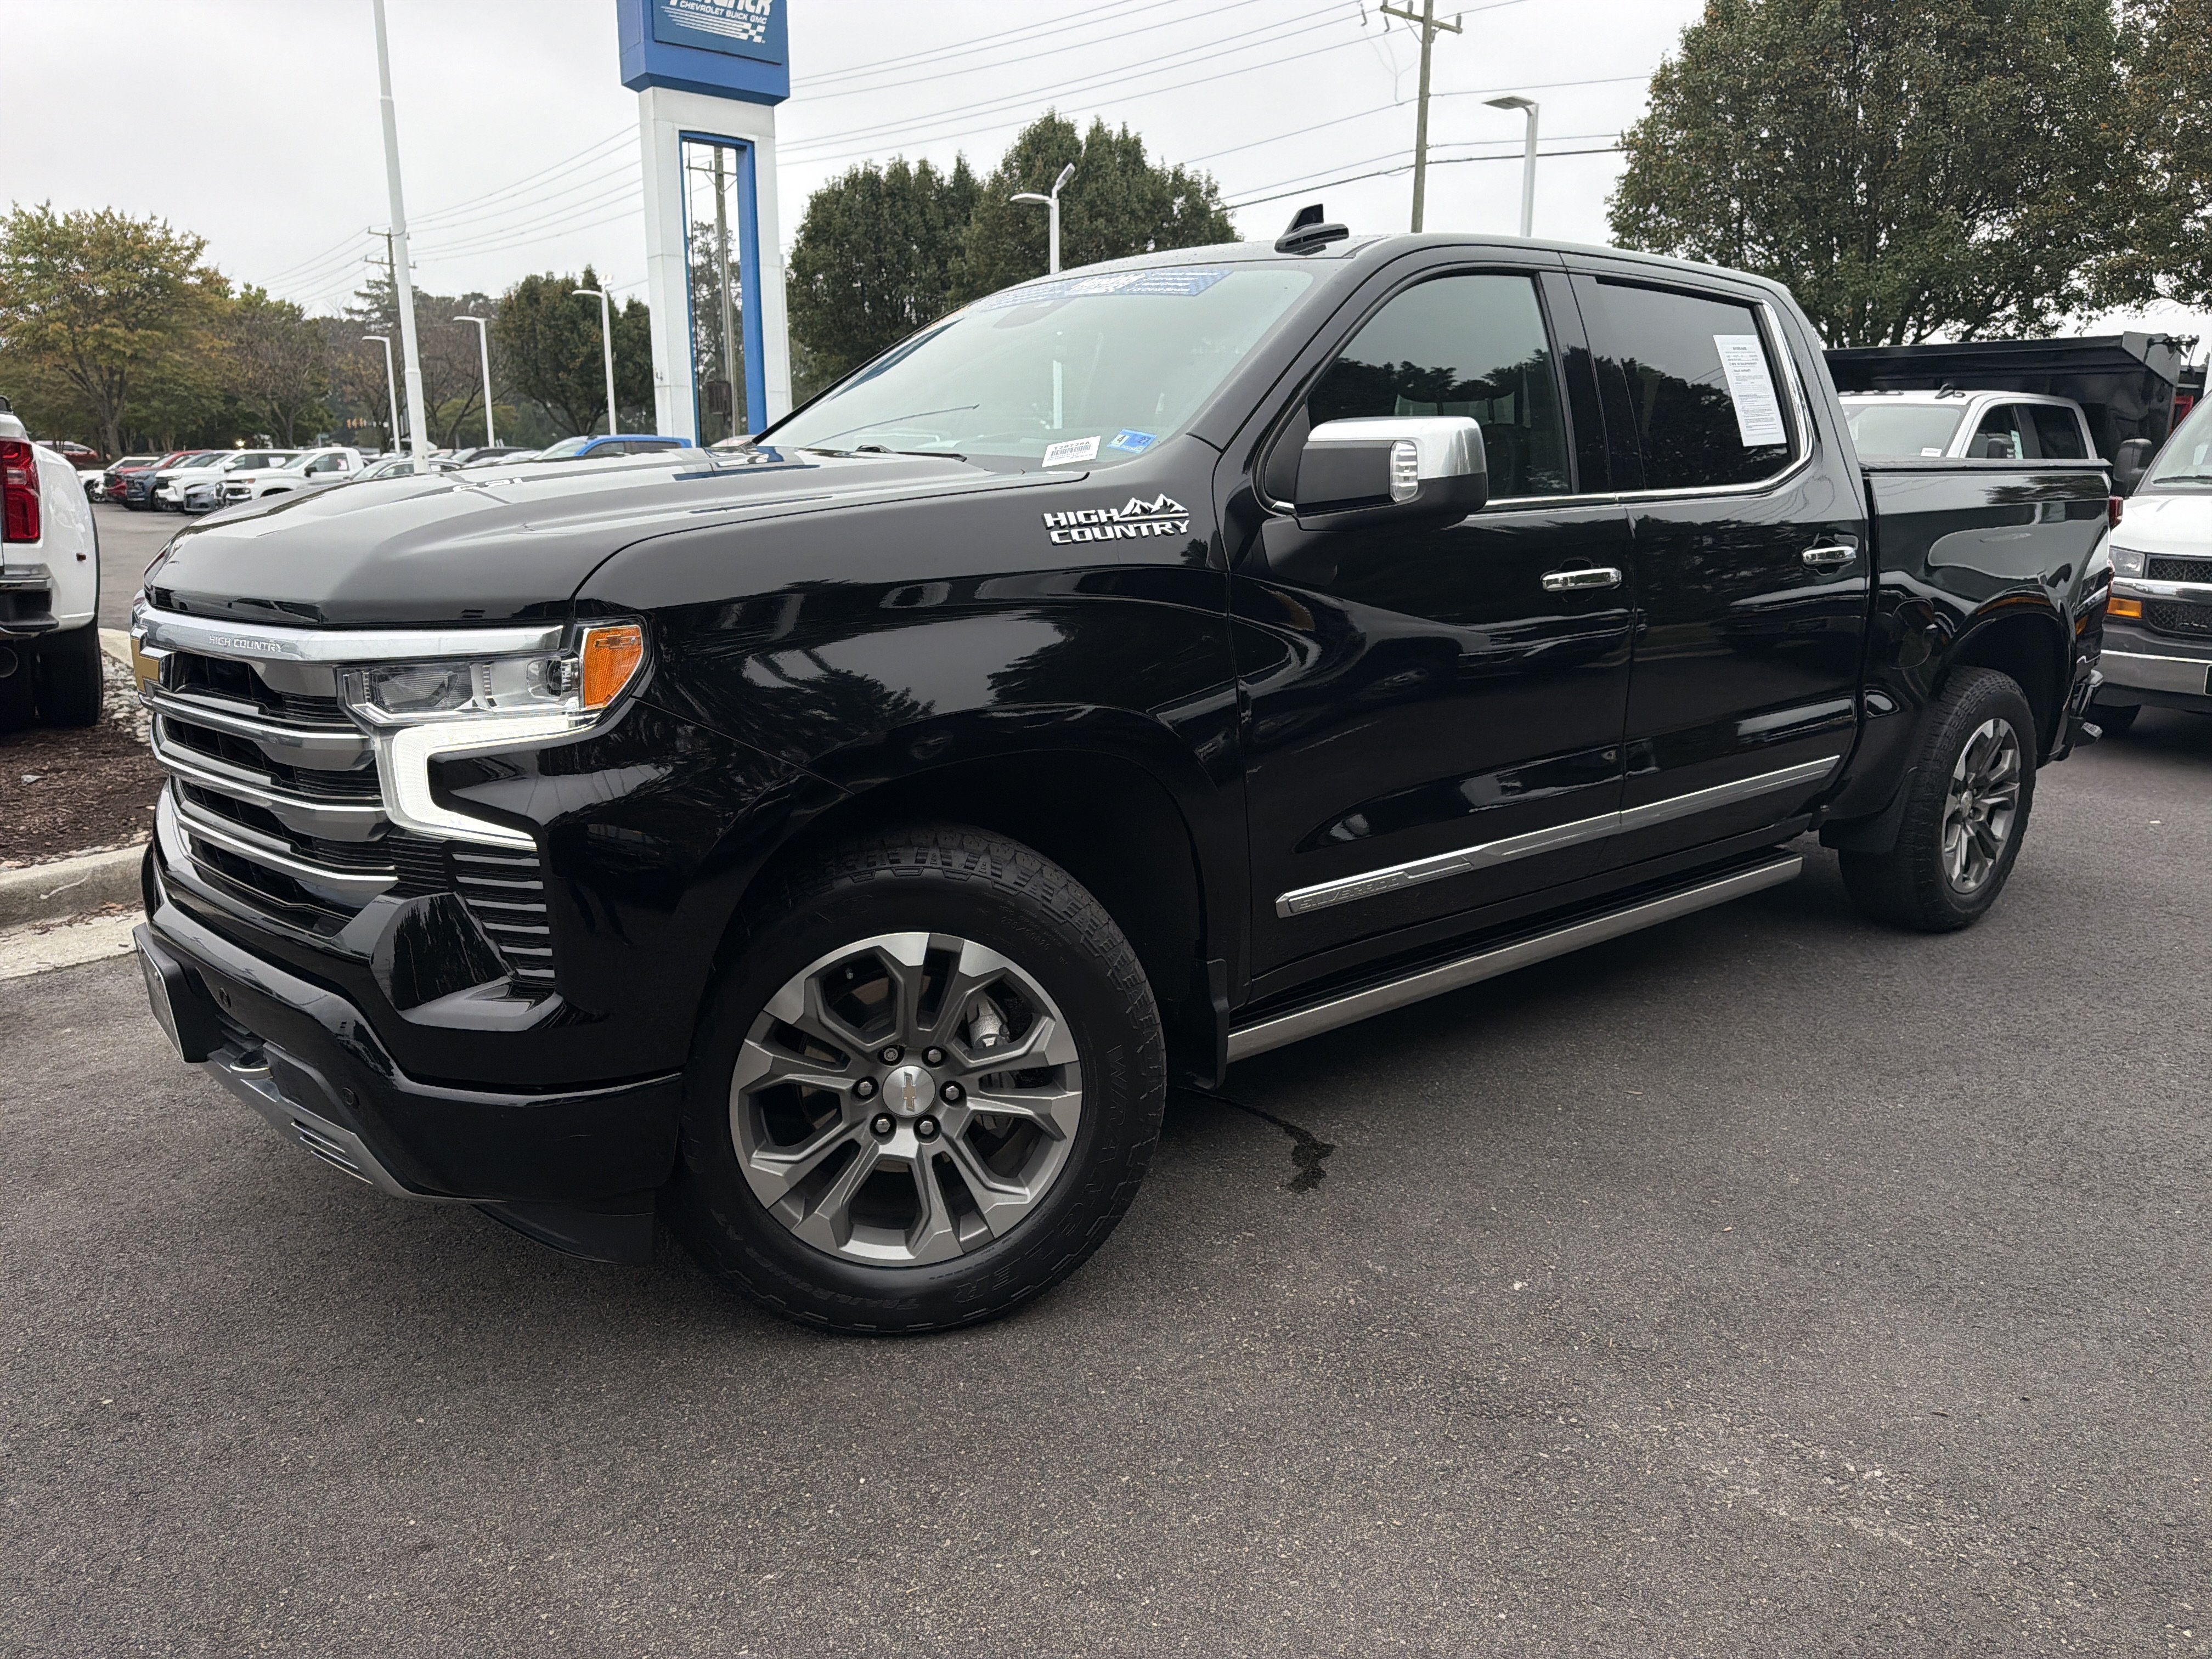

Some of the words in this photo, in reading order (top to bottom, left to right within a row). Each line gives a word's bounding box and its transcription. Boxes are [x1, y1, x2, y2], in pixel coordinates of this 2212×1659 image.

[679, 1, 725, 16] CHEVROLET
[725, 9, 748, 21] BUICK
[749, 14, 768, 25] GMC
[1116, 435, 1126, 443] 4
[1042, 507, 1120, 530] HIGH
[1049, 520, 1190, 545] COUNTRY
[208, 635, 232, 646] HIGH
[233, 638, 285, 653] COUNTRY
